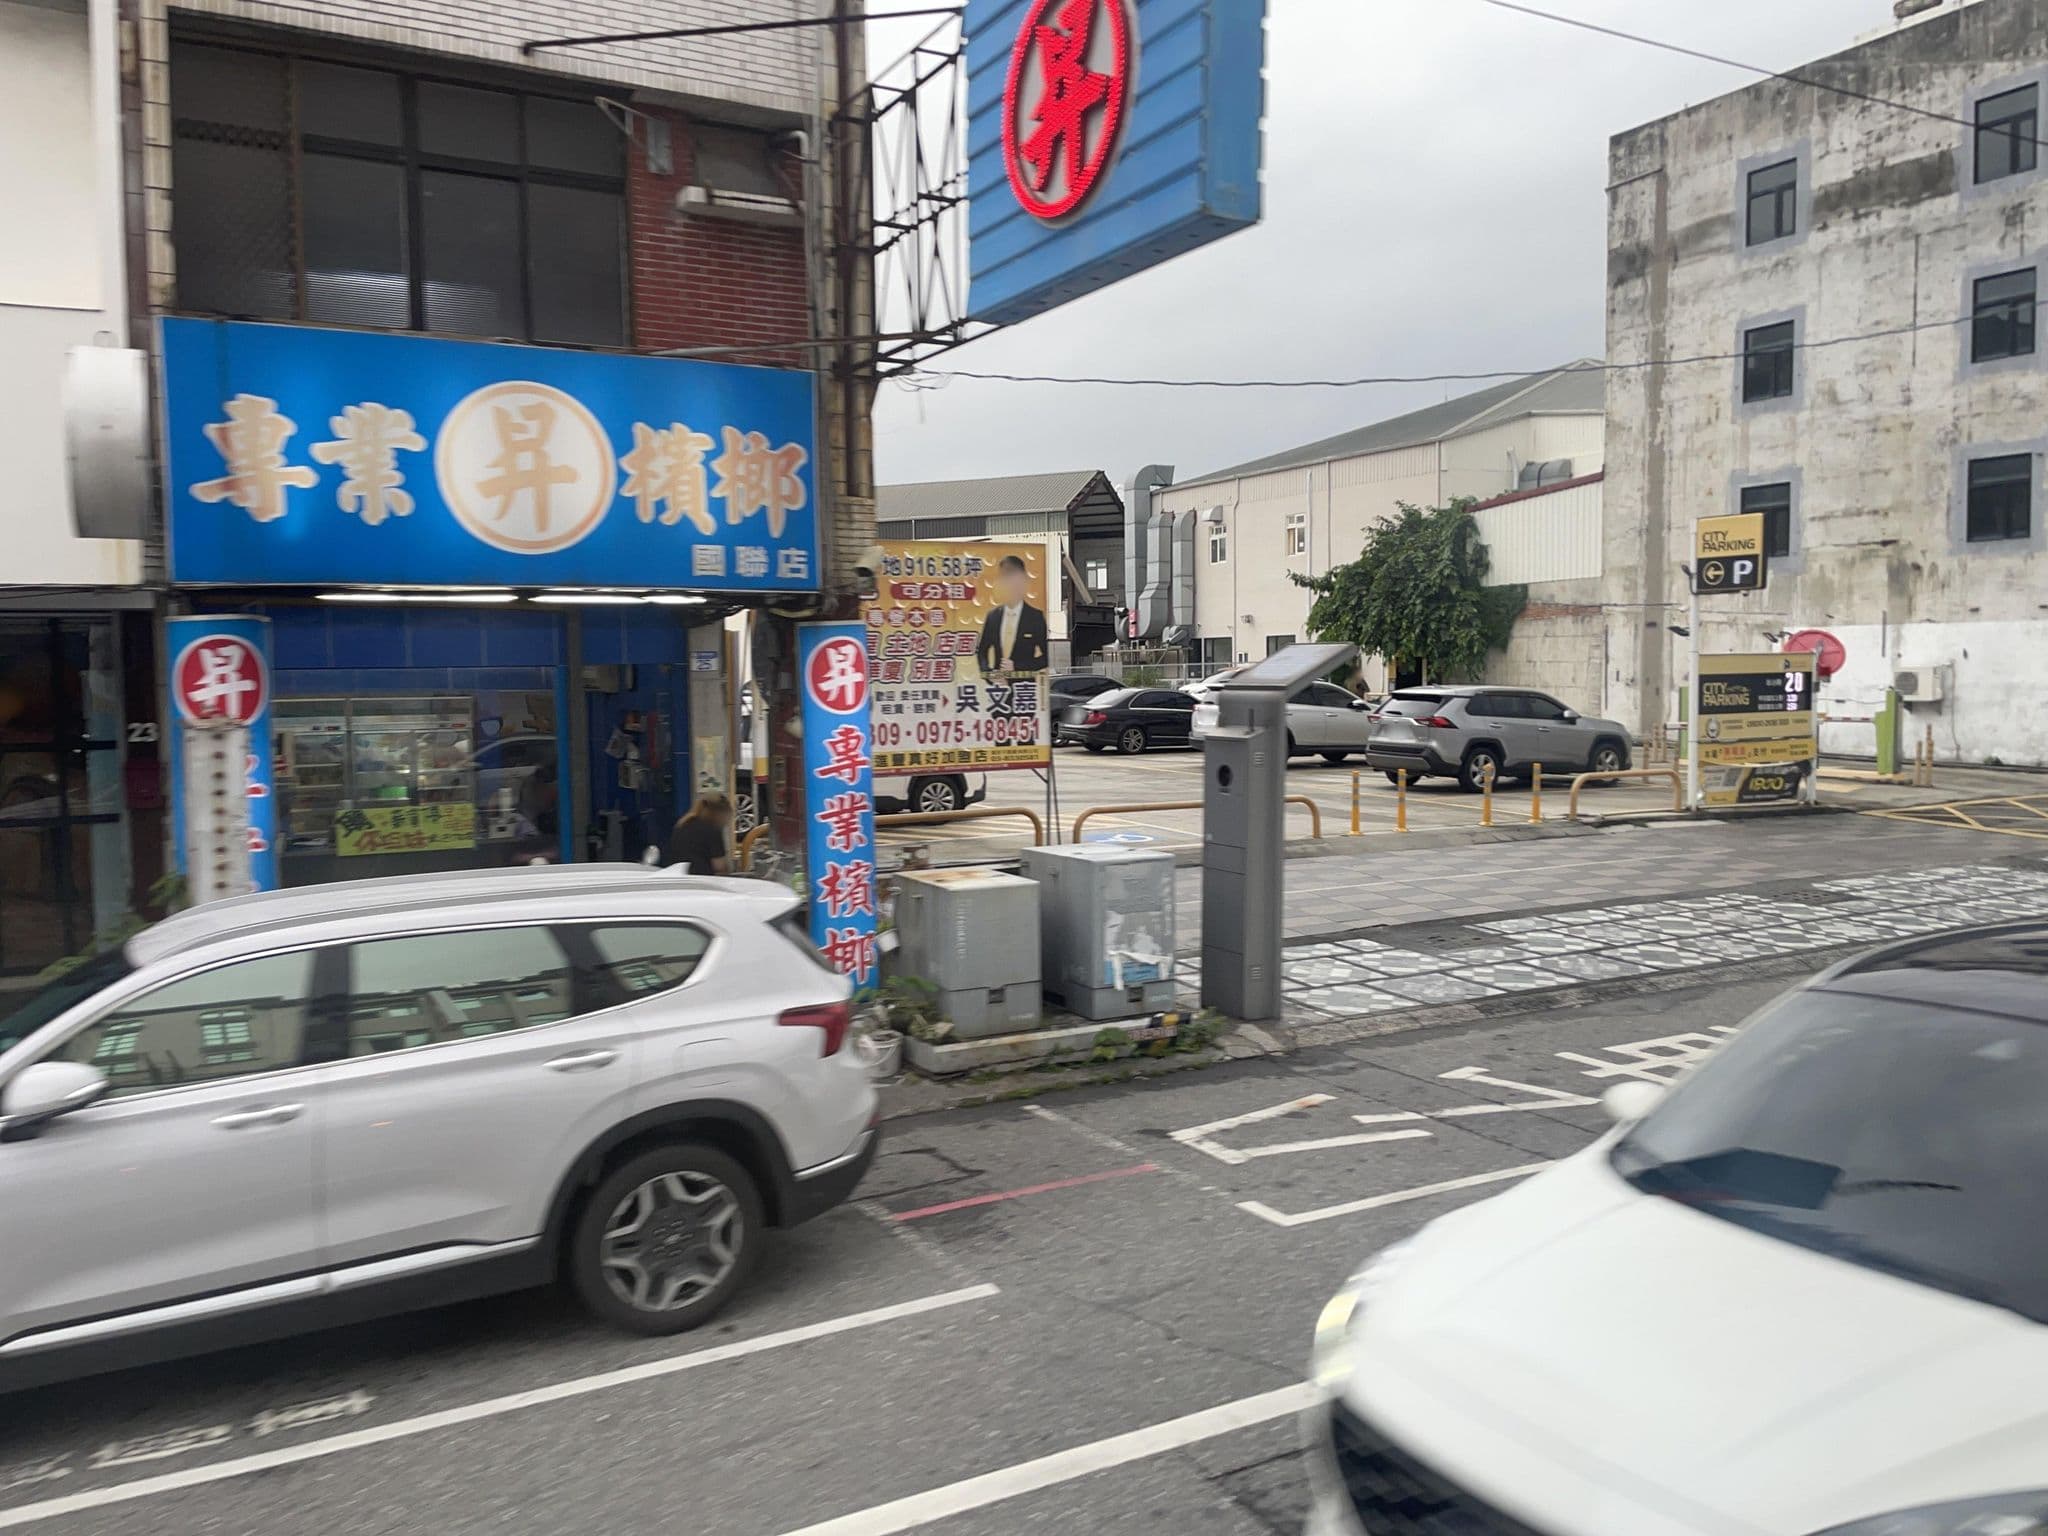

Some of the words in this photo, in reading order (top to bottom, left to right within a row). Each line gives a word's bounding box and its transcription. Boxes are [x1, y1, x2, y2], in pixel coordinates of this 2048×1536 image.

[189, 393, 429, 526] 專業
[474, 402, 581, 533] 昇
[620, 420, 809, 540] 檳榔
[1702, 530, 1729, 543] CITY
[1702, 538, 1756, 553] PARKING
[691, 543, 810, 580] 國聯店
[1732, 559, 1754, 585] P
[901, 584, 969, 600] 可分租
[885, 632, 929, 655] 土地
[935, 632, 978, 655] 店面
[187, 644, 258, 719] 昇
[817, 643, 865, 706] 昇
[911, 658, 953, 682] 別墅
[1702, 681, 1728, 694] CITY
[1784, 672, 1804, 693] 20
[955, 682, 1037, 713] 吳文嘉
[1702, 692, 1751, 707] PARKING
[127, 722, 159, 742] 23
[814, 724, 877, 985] 專業檳榔
